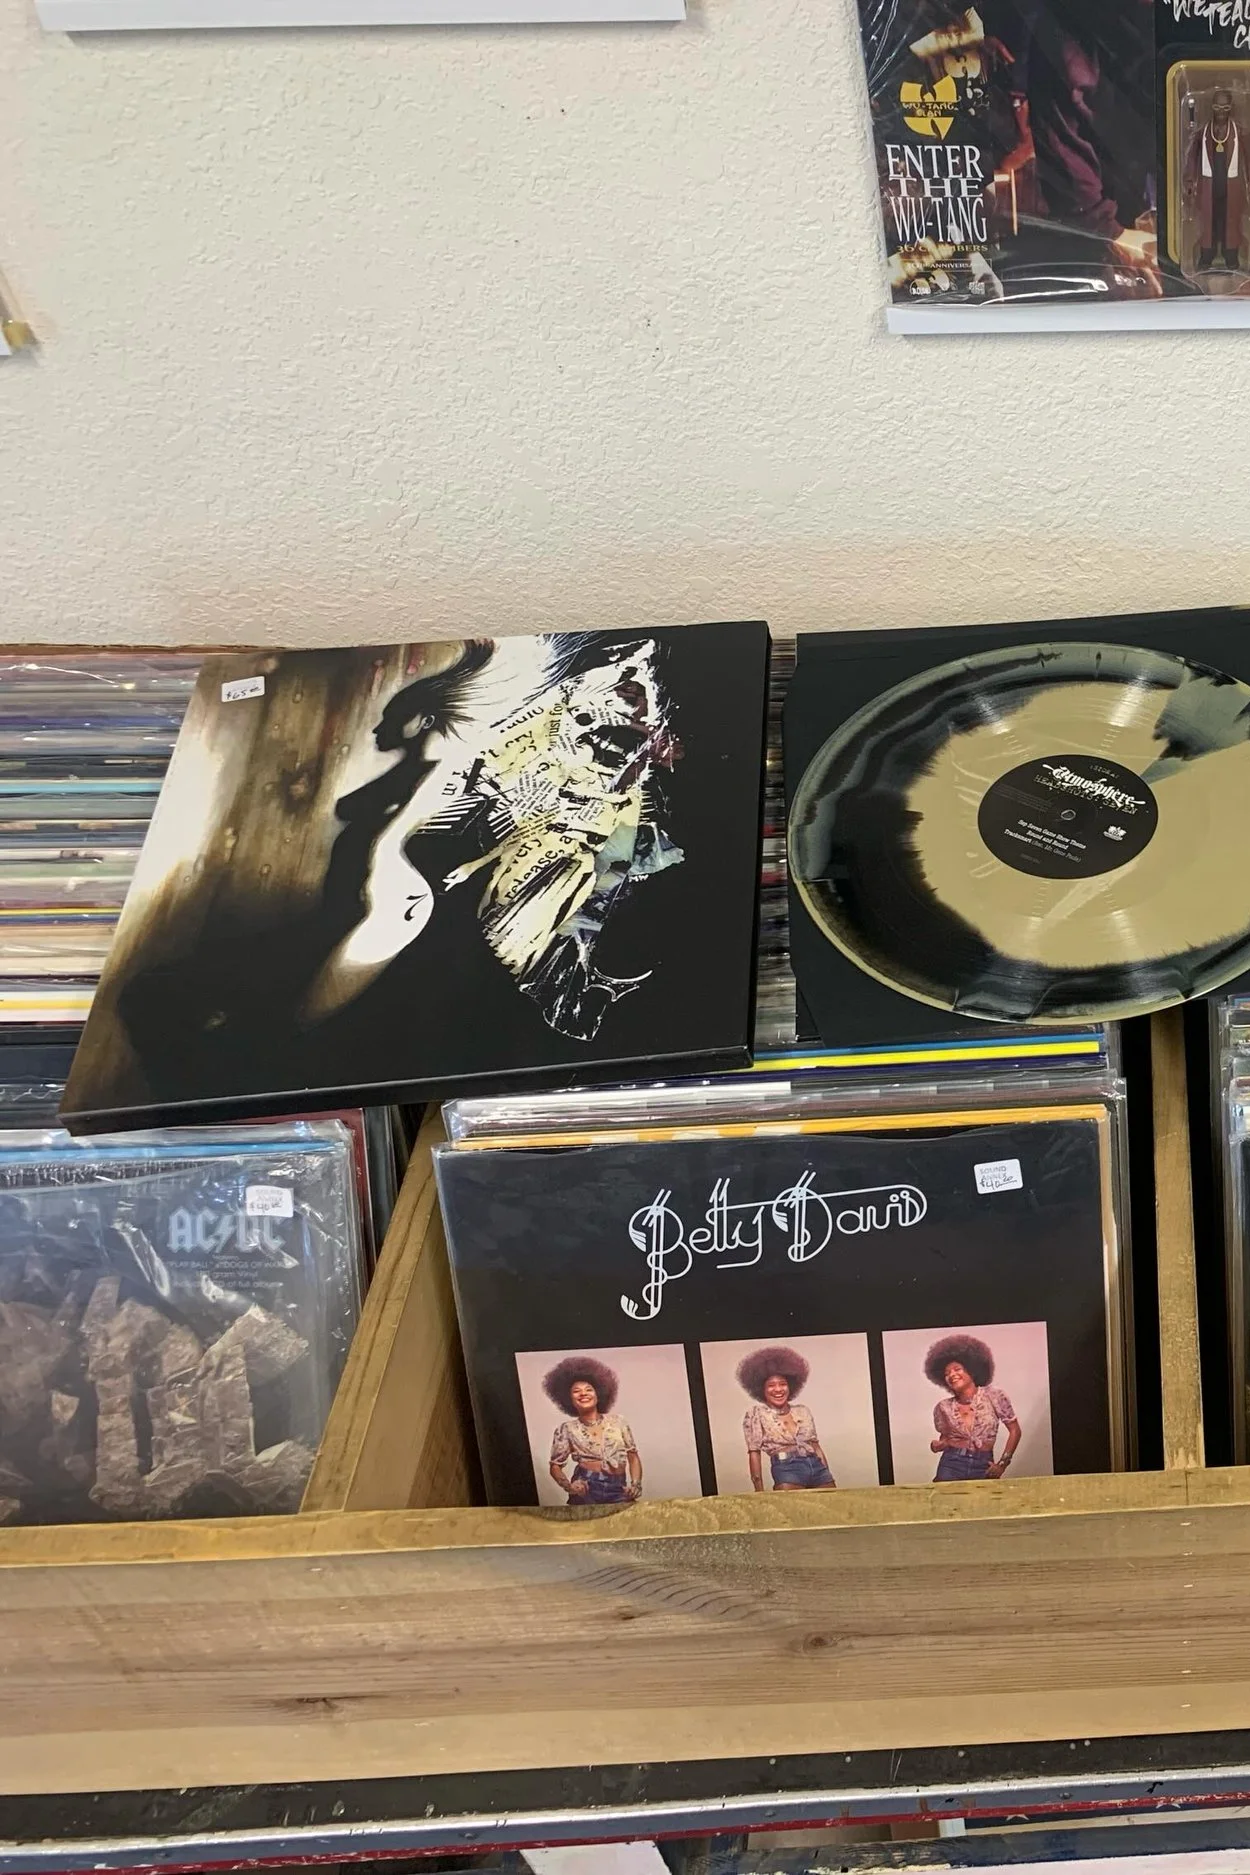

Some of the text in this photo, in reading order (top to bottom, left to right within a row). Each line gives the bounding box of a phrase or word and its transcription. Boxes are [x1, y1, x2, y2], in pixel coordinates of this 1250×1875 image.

[885, 144, 985, 180] ENTER
[889, 177, 984, 198] THE
[890, 196, 988, 244] WU-TANG
[1043, 764, 1146, 808] Atmosphere
[620, 1170, 928, 1321] Betty Davis
